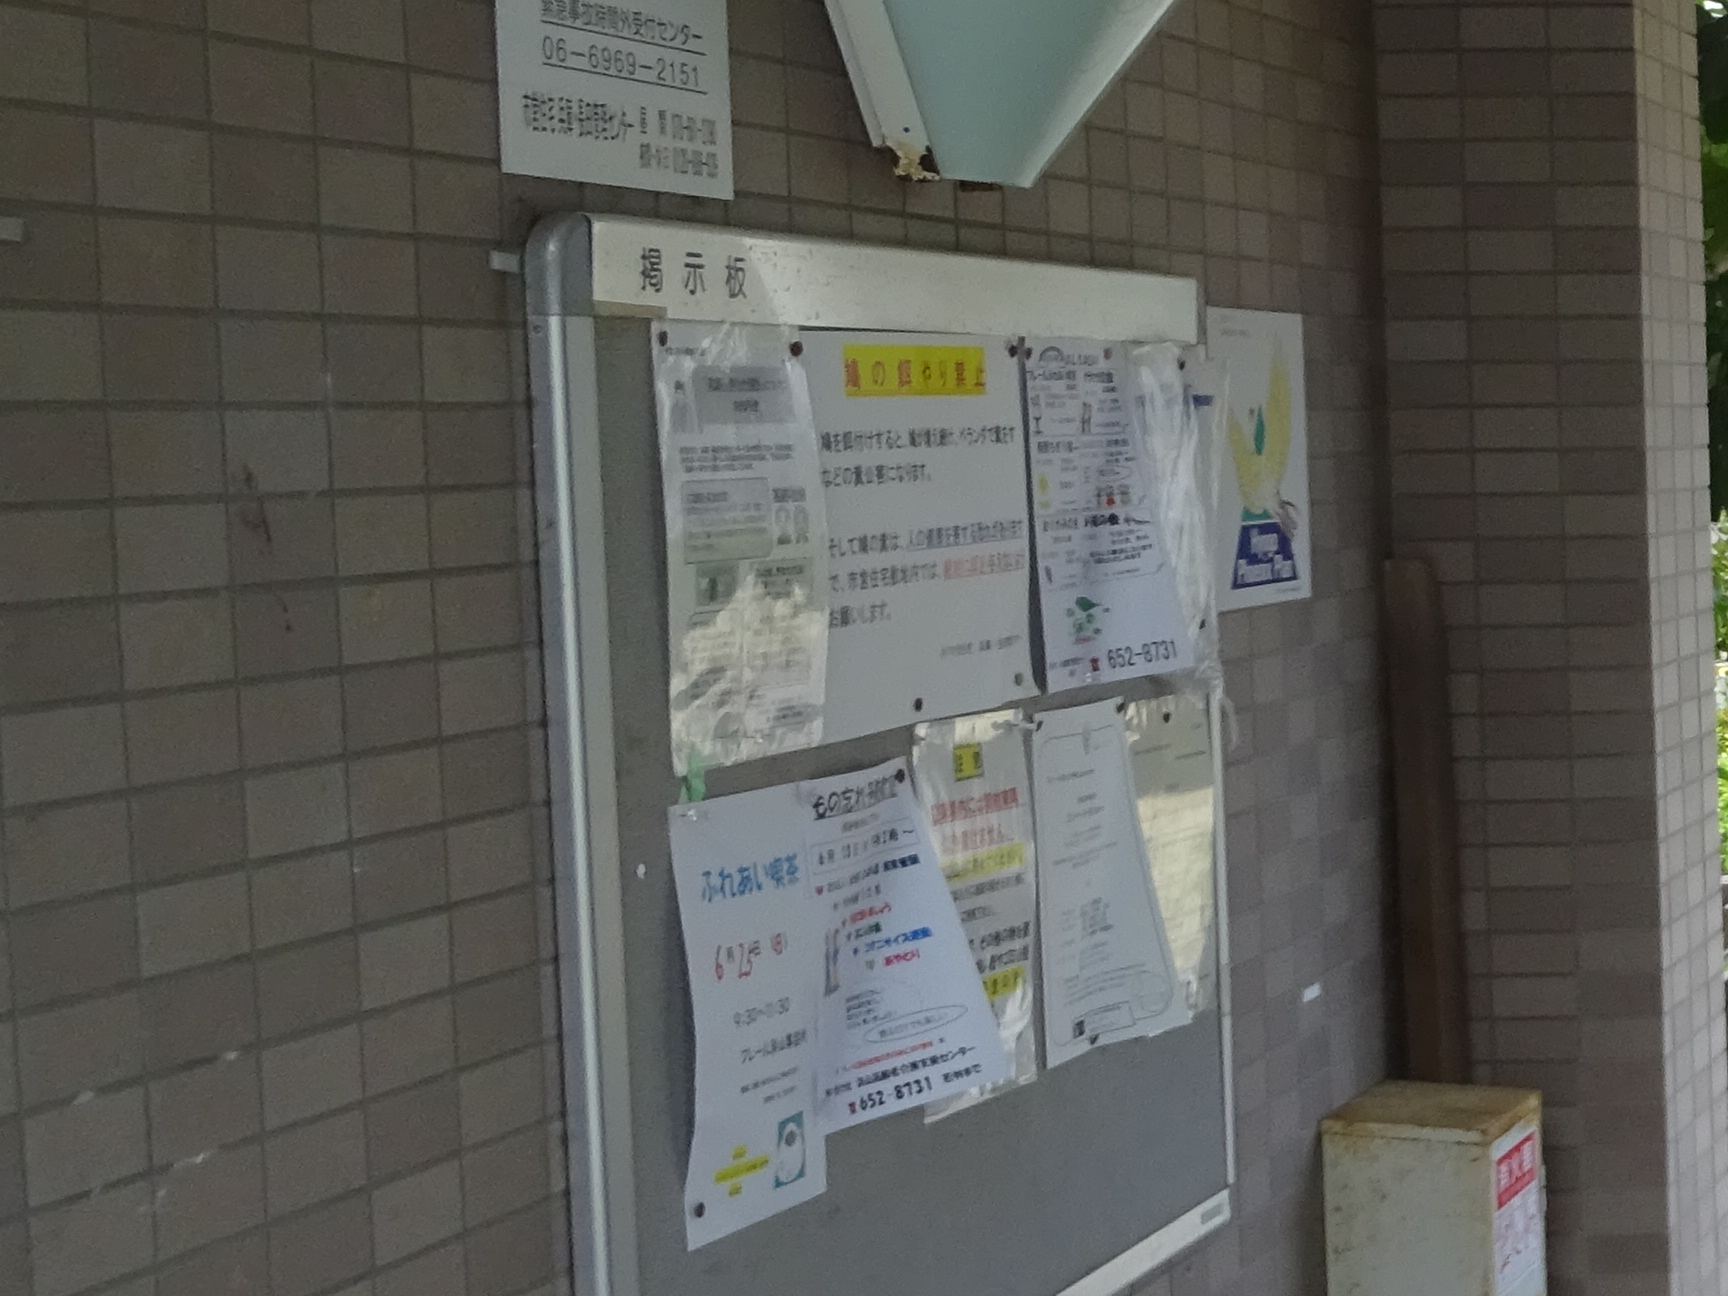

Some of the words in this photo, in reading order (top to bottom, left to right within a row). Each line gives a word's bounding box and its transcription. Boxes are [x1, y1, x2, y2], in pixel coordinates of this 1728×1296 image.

[542, 35, 699, 88] 06-6969-2151
[639, 246, 747, 299] 掲示板
[1107, 639, 1177, 669] 652-8731
[701, 850, 799, 906] ふれあい喫茶
